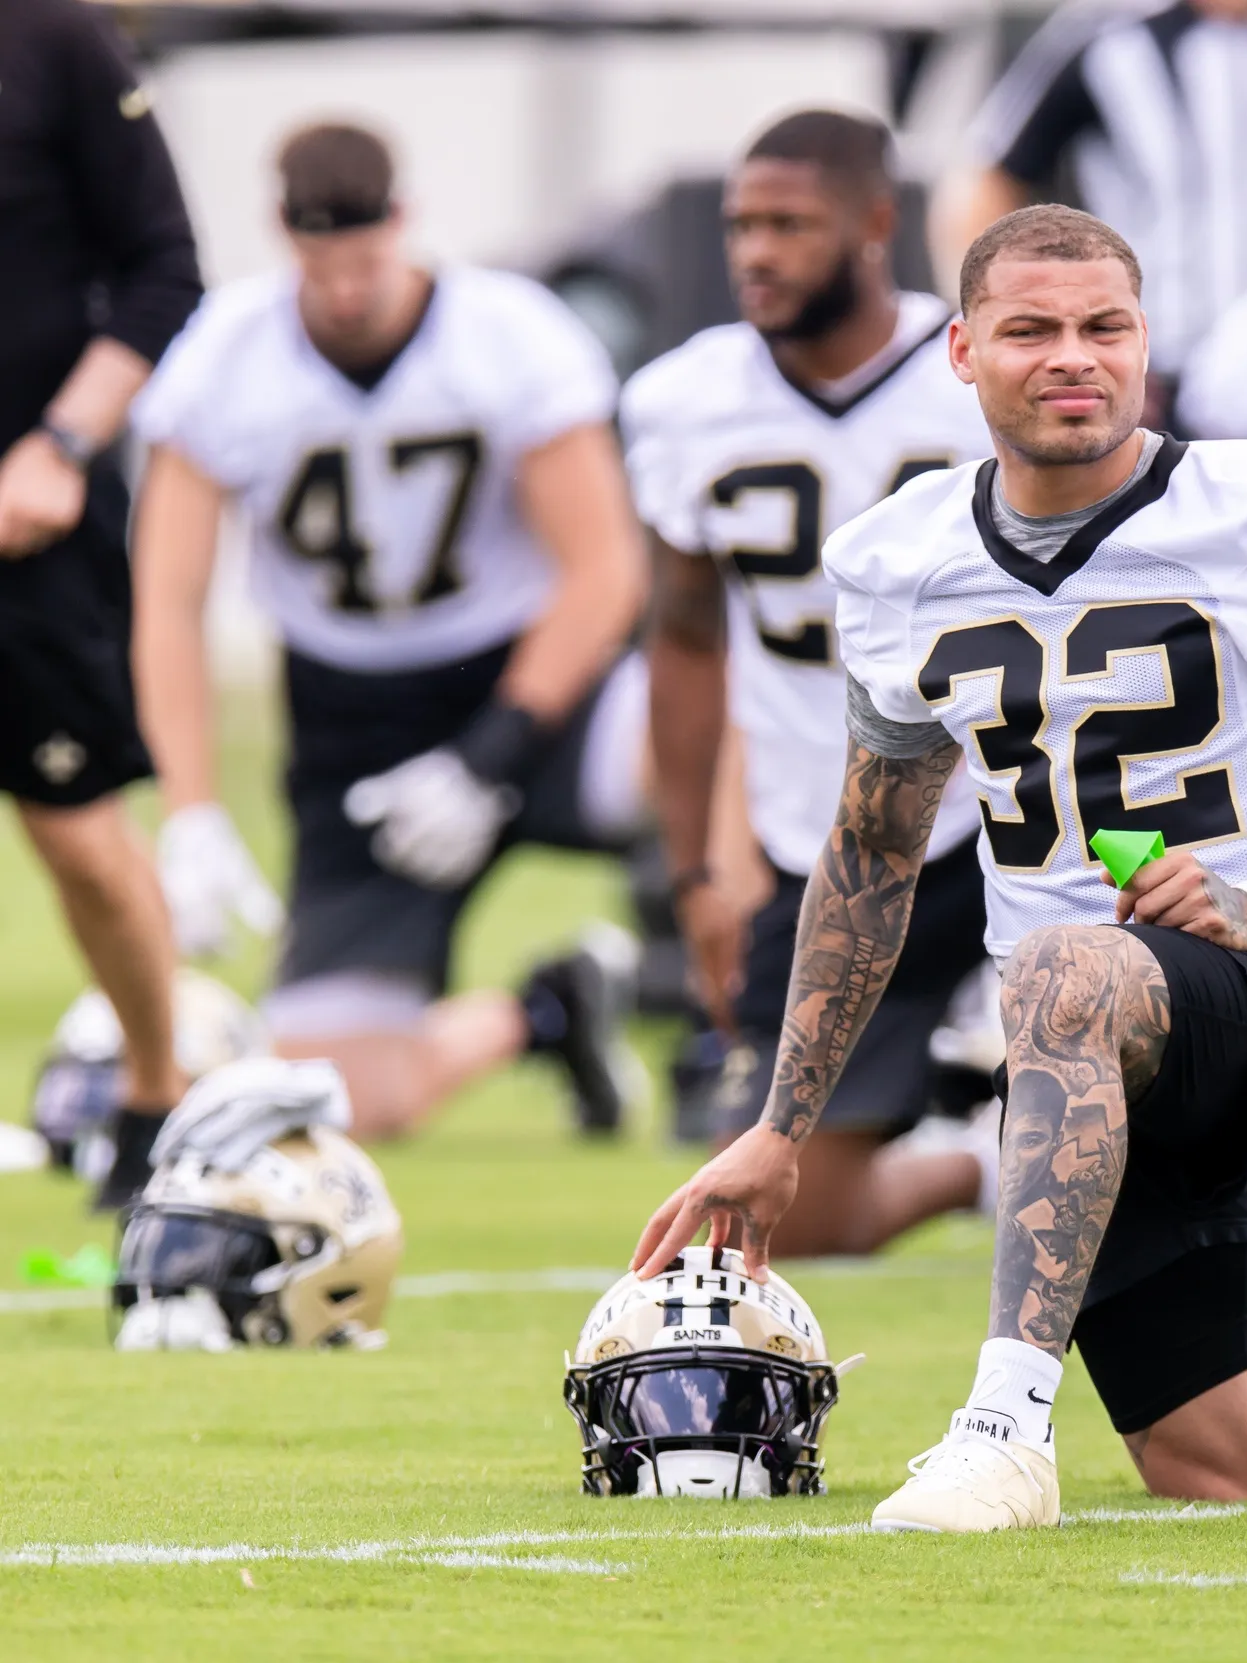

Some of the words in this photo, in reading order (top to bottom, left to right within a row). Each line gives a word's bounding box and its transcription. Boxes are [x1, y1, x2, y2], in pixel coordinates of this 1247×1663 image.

[279, 428, 484, 612] 47
[703, 454, 955, 667] 2
[914, 599, 1247, 873] 32
[673, 1329, 721, 1342] SAINTS
